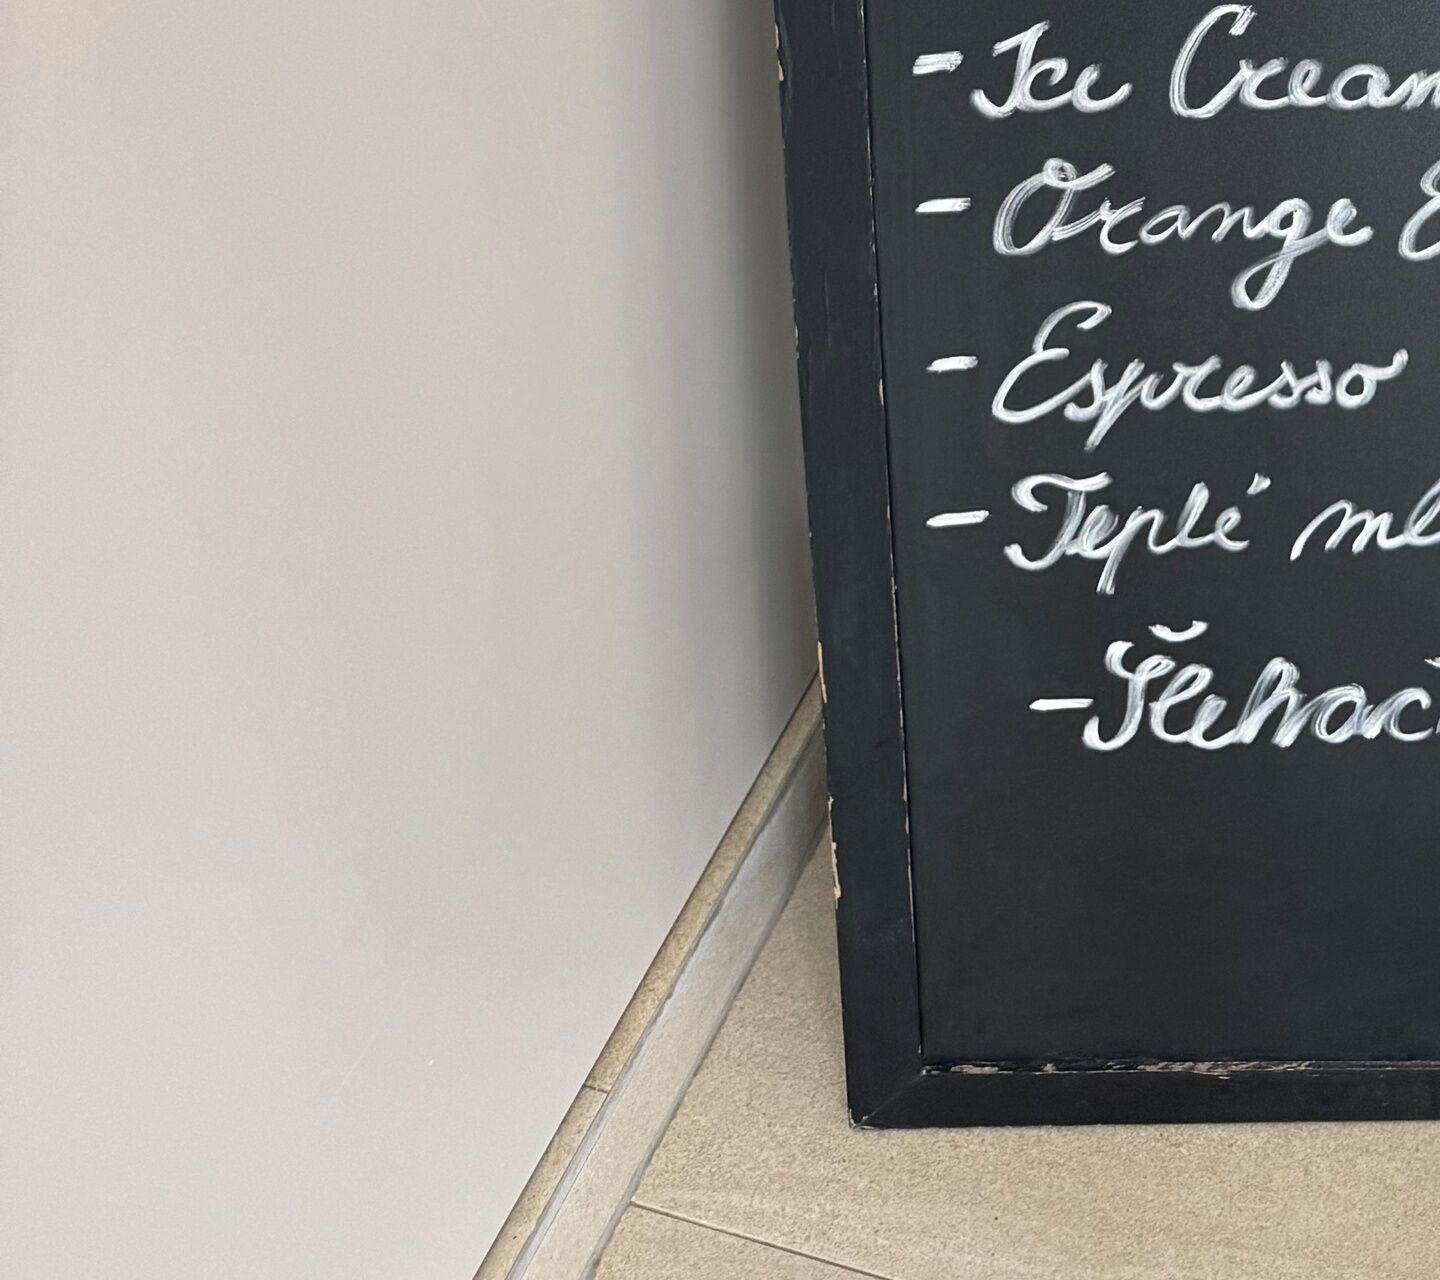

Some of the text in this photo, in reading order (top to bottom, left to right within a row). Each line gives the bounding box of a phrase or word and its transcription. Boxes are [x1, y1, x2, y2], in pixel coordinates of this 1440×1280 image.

[971, 22, 1132, 119] Ice
[993, 158, 1373, 310] Orange
[992, 301, 1408, 450] Espresso
[1004, 472, 1271, 594] Teplé
